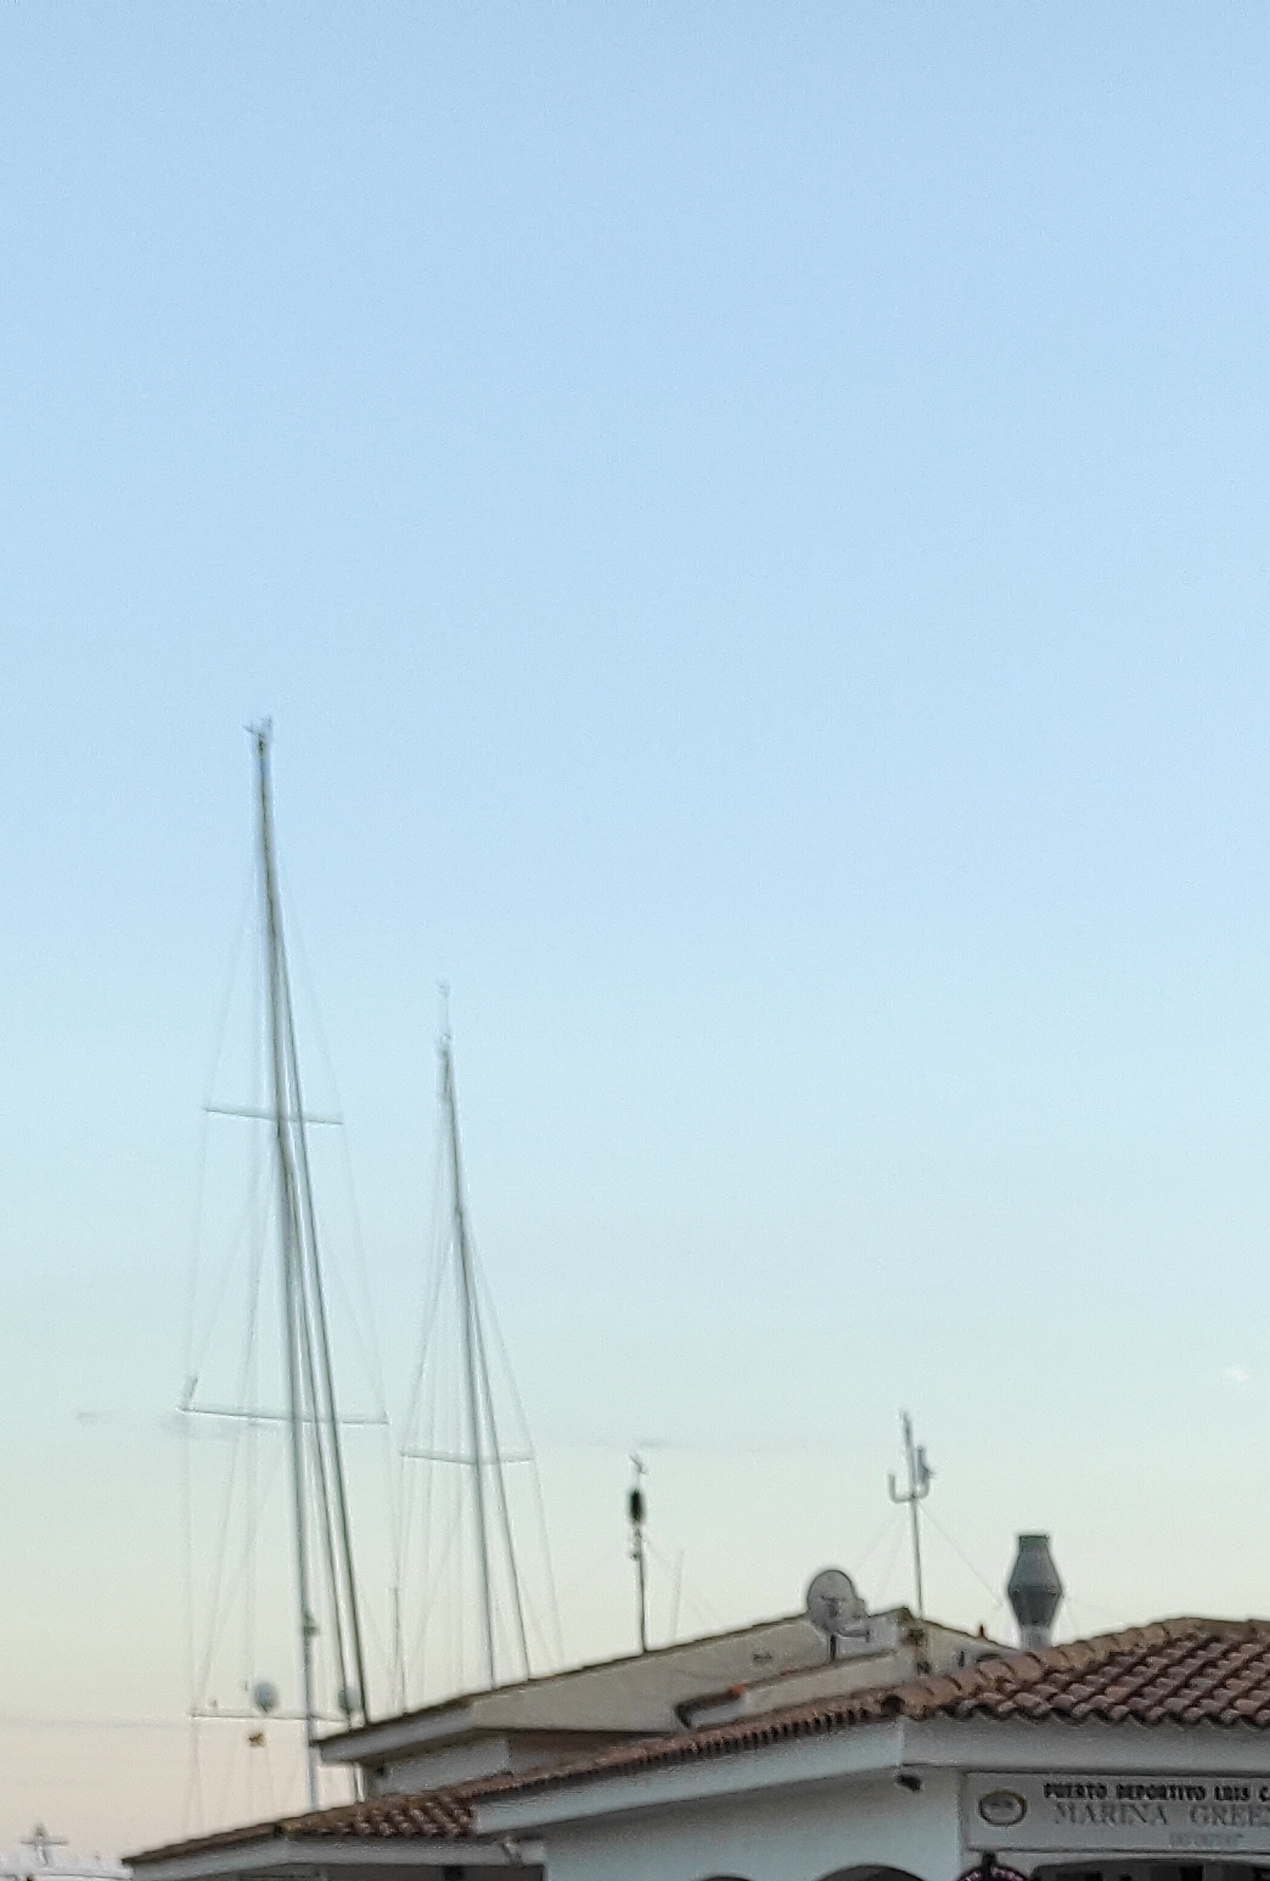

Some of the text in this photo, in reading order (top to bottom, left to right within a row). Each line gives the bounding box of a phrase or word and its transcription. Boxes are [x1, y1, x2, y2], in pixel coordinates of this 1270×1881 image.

[1044, 1783, 1107, 1799] PUERTO
[1117, 1783, 1206, 1801] DEPORTIVO
[1054, 1802, 1169, 1826] MARINA
